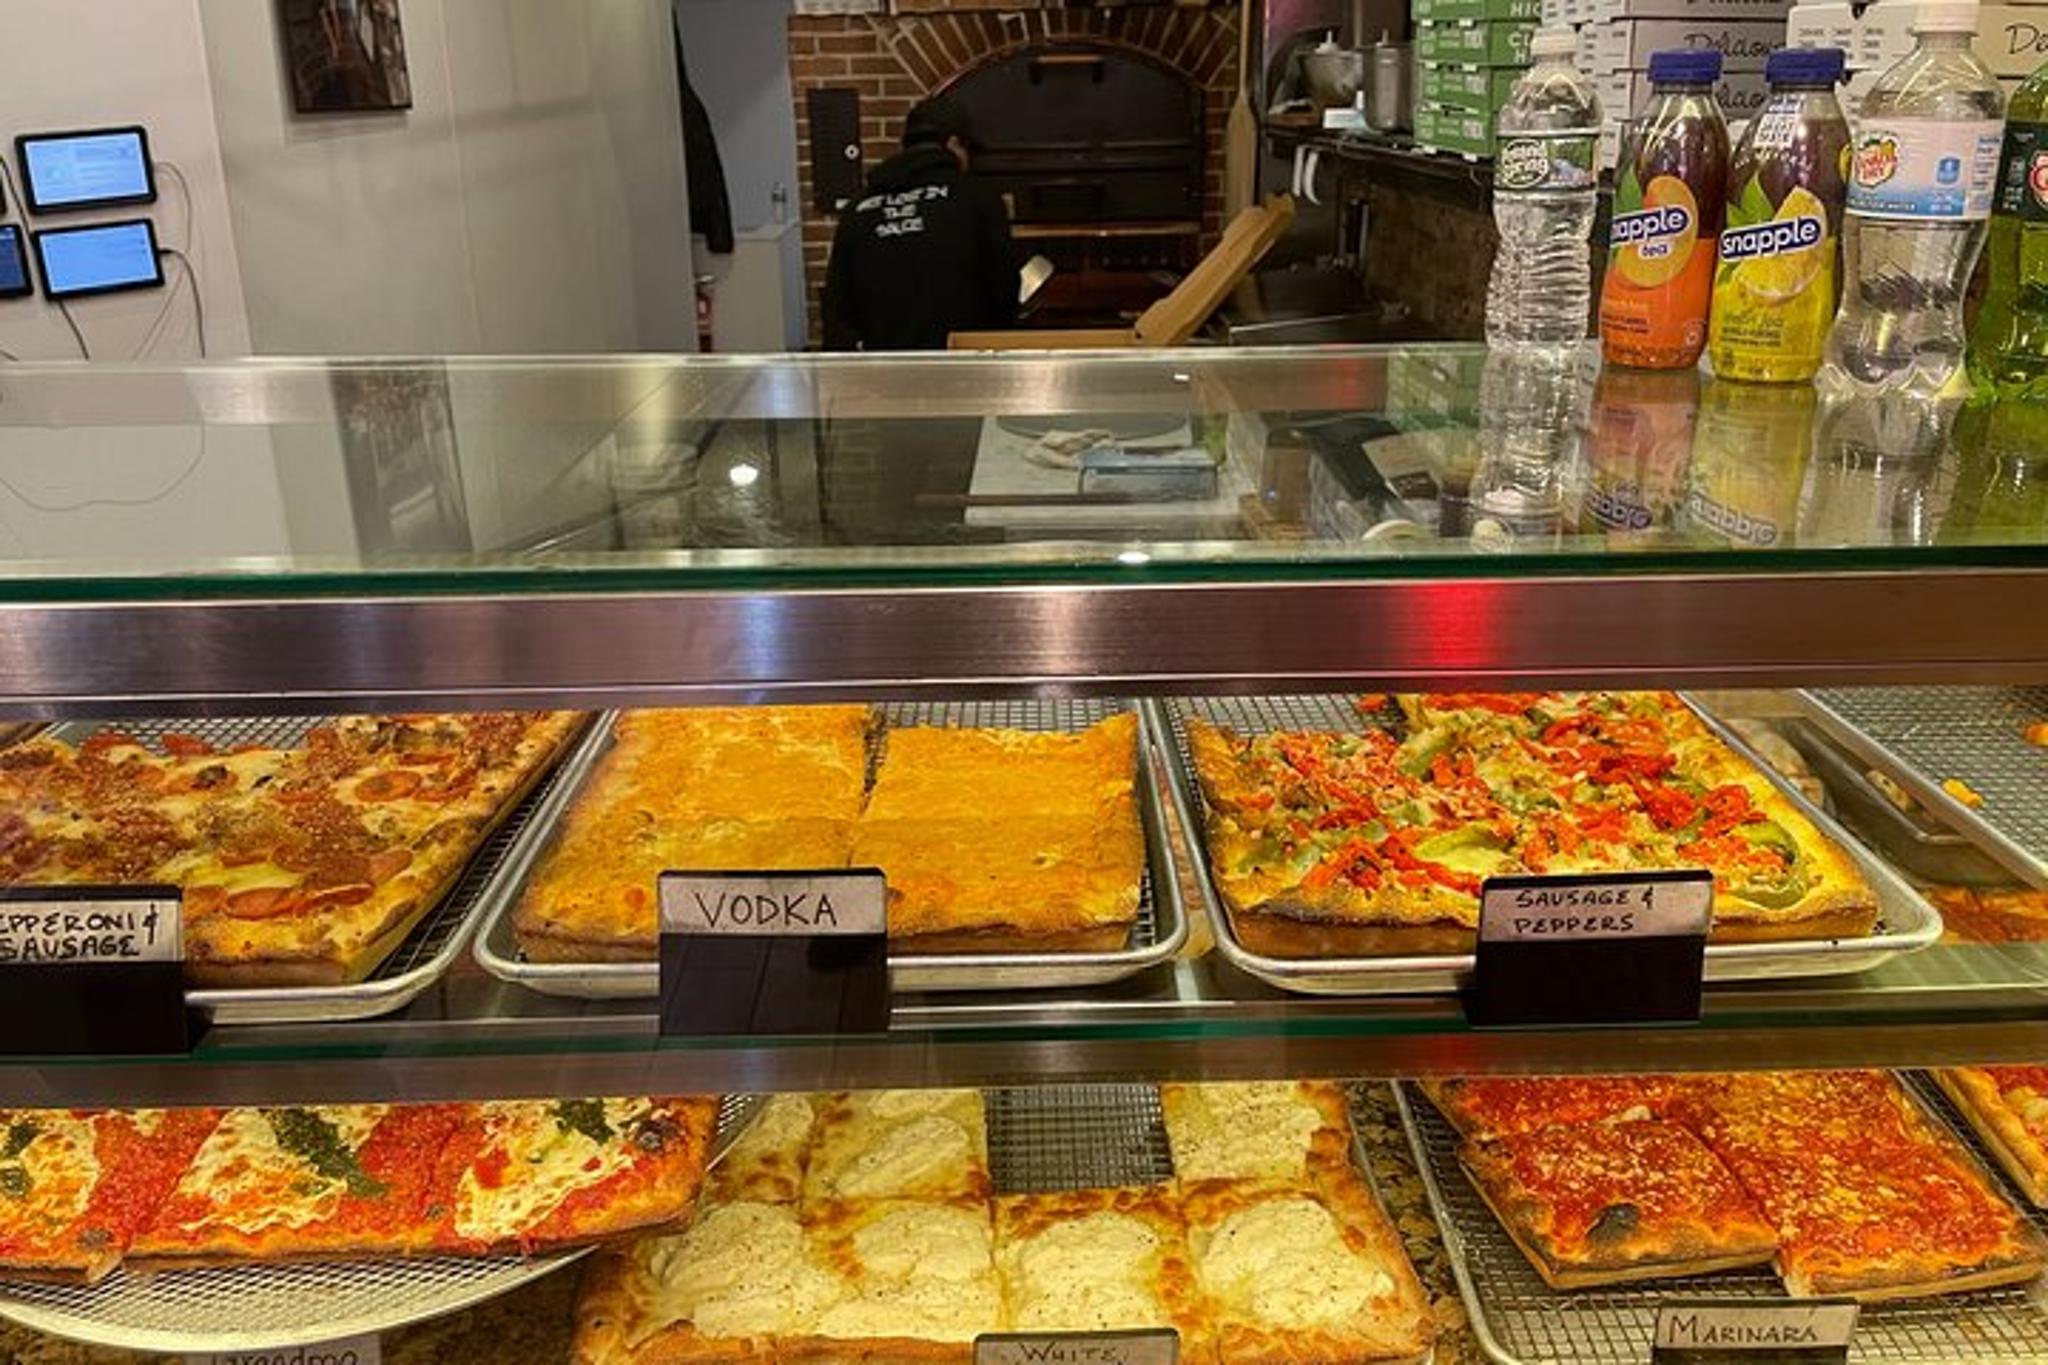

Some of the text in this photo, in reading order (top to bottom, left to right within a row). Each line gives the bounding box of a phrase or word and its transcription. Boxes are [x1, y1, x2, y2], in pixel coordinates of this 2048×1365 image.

[1723, 216, 1817, 256] snapple
[692, 892, 837, 928] VODKA
[1516, 889, 1631, 908] SAUSAGE
[0, 912, 135, 936] EPPERONI
[1514, 913, 1635, 934] PEPPERS
[0, 934, 140, 961] SAUSAGE
[1668, 1314, 1818, 1344] MARINARA
[1018, 1341, 1117, 1363] WHITE
